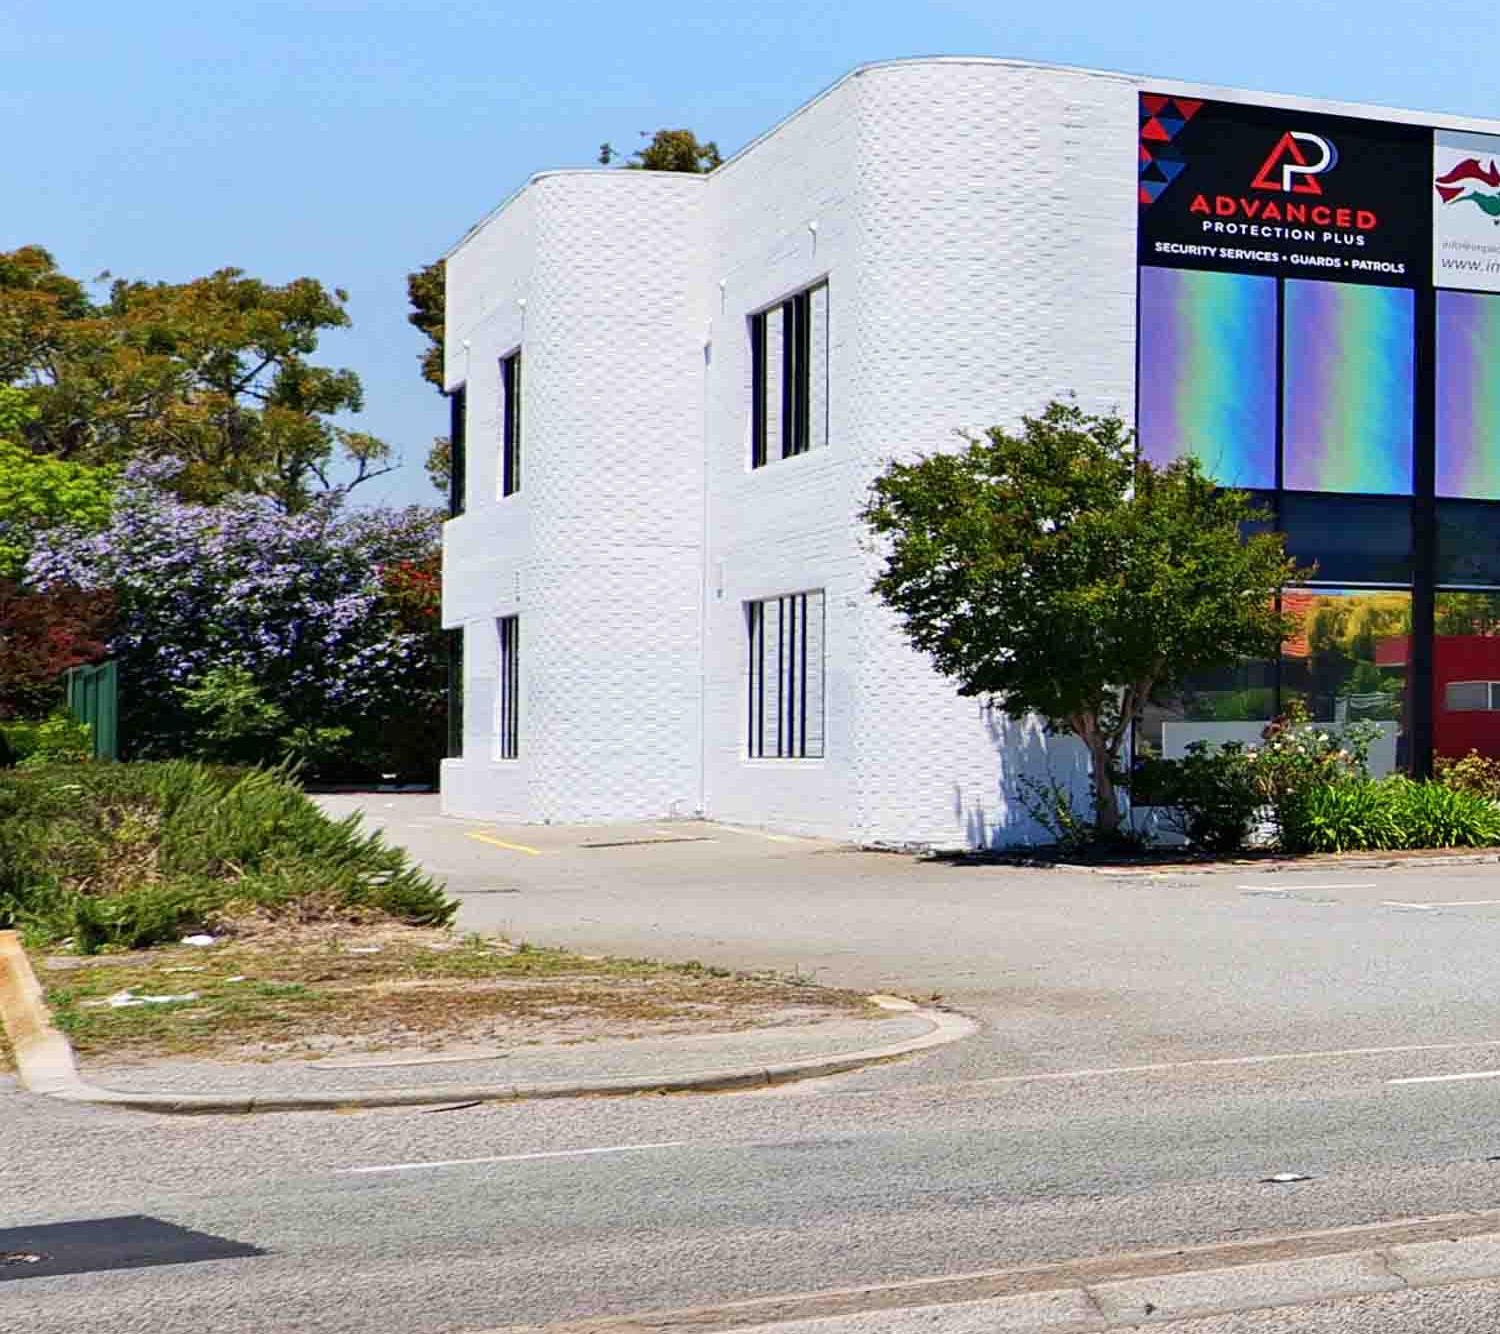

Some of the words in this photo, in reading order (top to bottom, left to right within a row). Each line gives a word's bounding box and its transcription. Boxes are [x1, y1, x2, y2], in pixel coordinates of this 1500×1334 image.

[1190, 194, 1377, 230] ADVANCED
[1202, 220, 1316, 242] PROTECTION
[1323, 231, 1366, 246] PLUS
[1155, 241, 1217, 258] SECURITY
[1218, 246, 1280, 263] SERVICES
[1290, 253, 1342, 268] GUARDS
[1351, 259, 1406, 274] PATROLS
